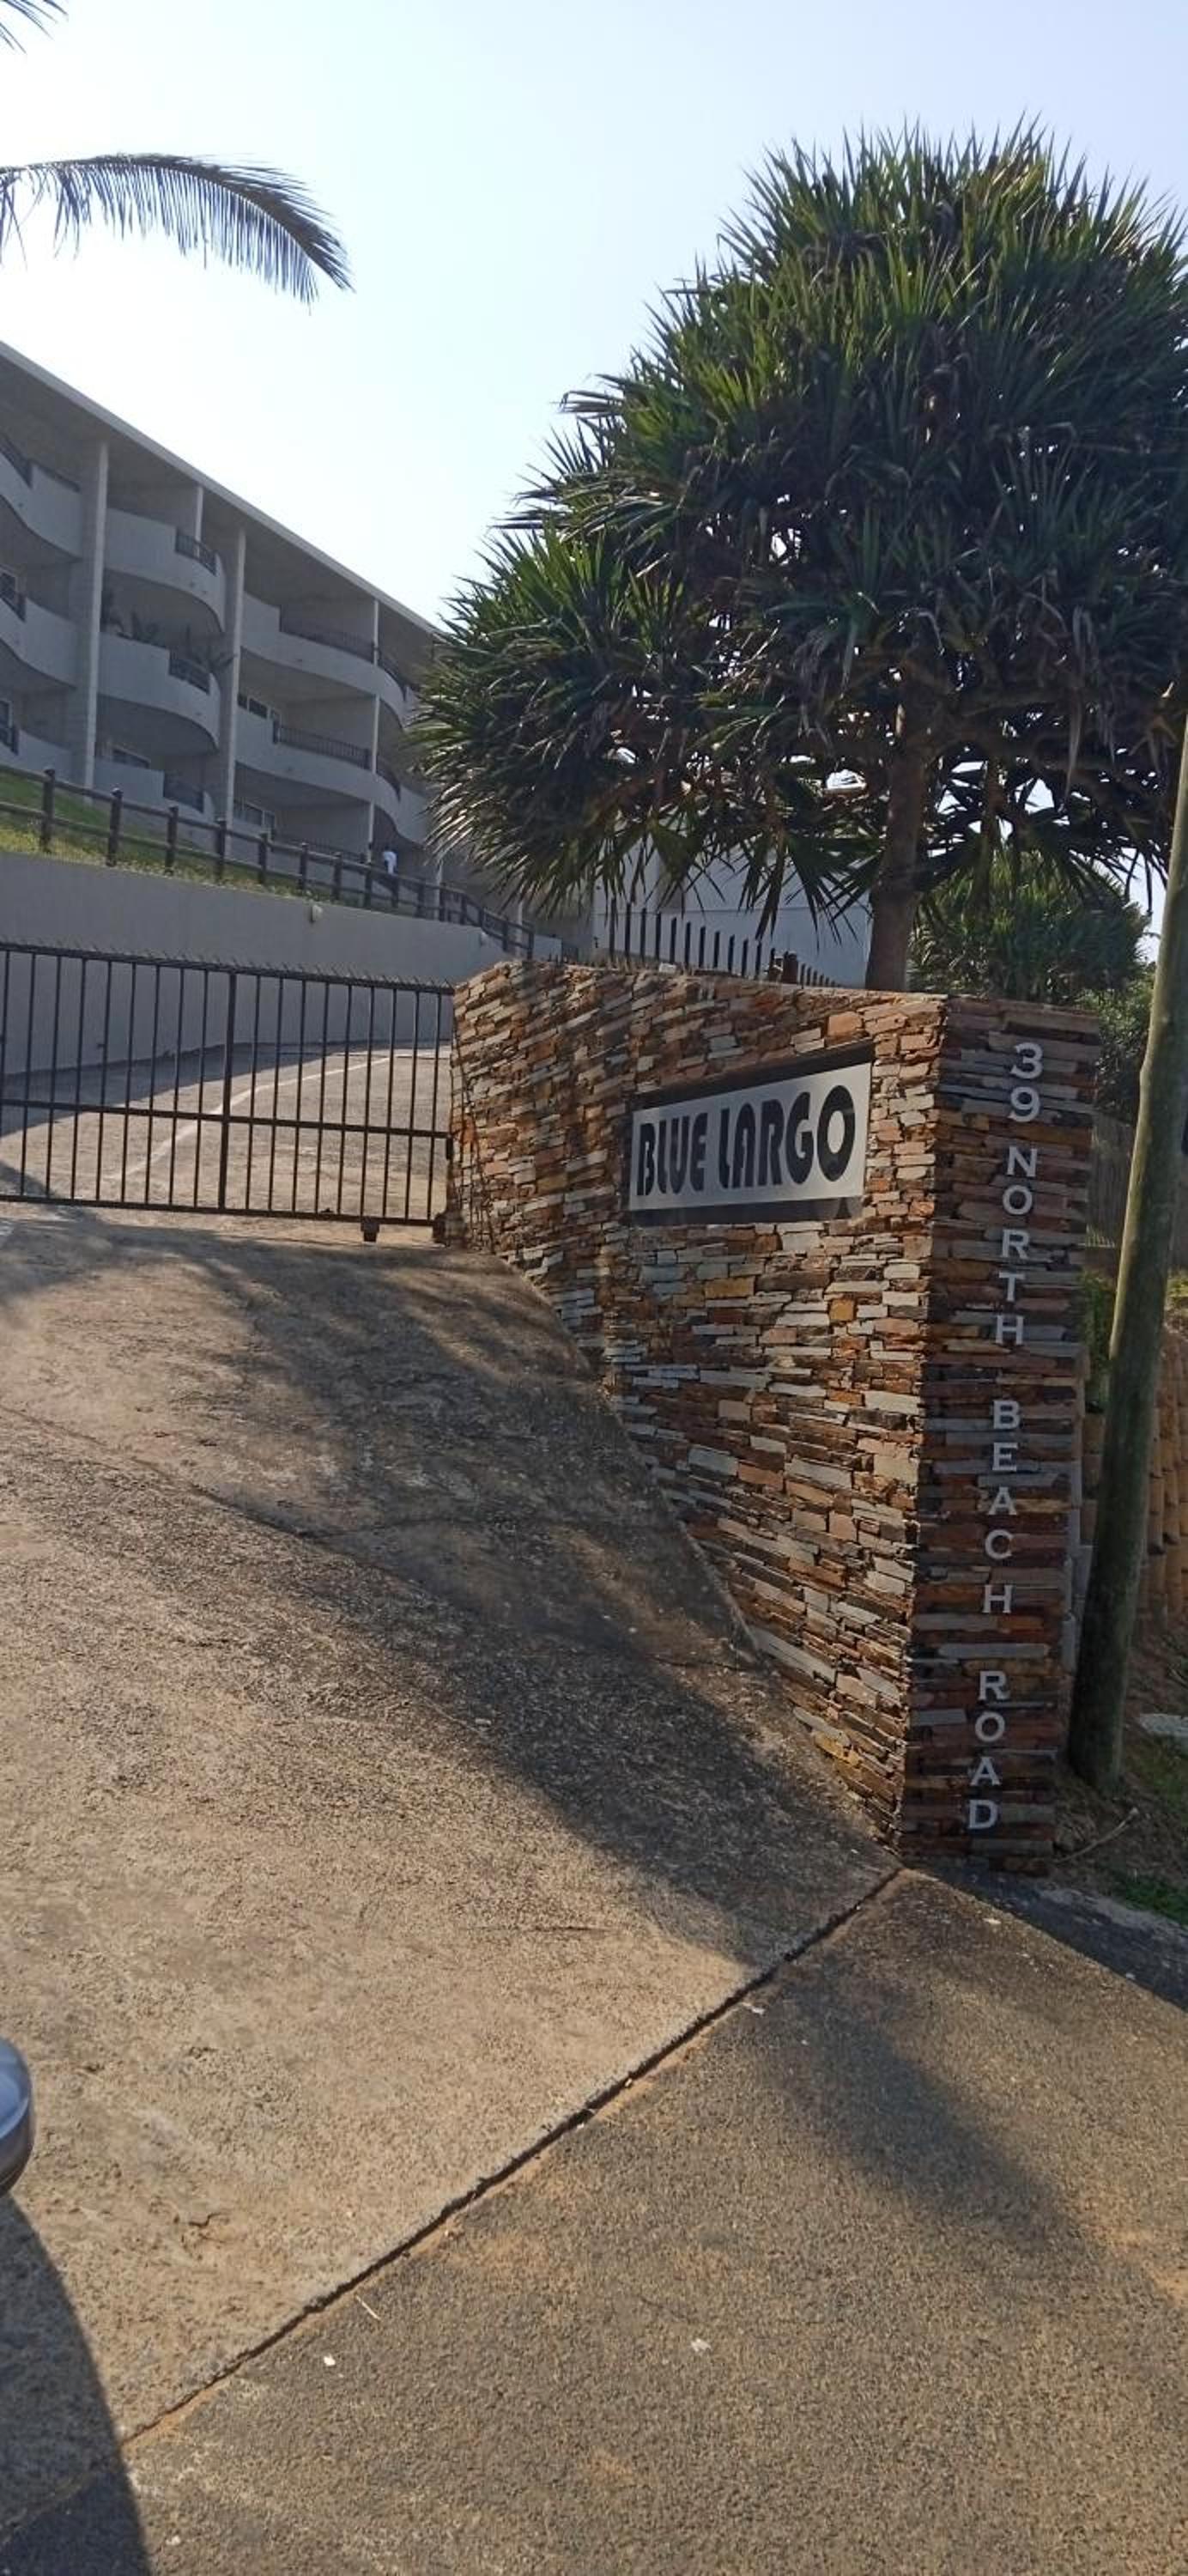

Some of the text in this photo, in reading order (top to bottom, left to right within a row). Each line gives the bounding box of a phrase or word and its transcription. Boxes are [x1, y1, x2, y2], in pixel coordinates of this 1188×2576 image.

[637, 1084, 856, 1196] BLUE LARGO
[967, 1042, 1044, 1830] 39 NORTH BEACH ROAD
